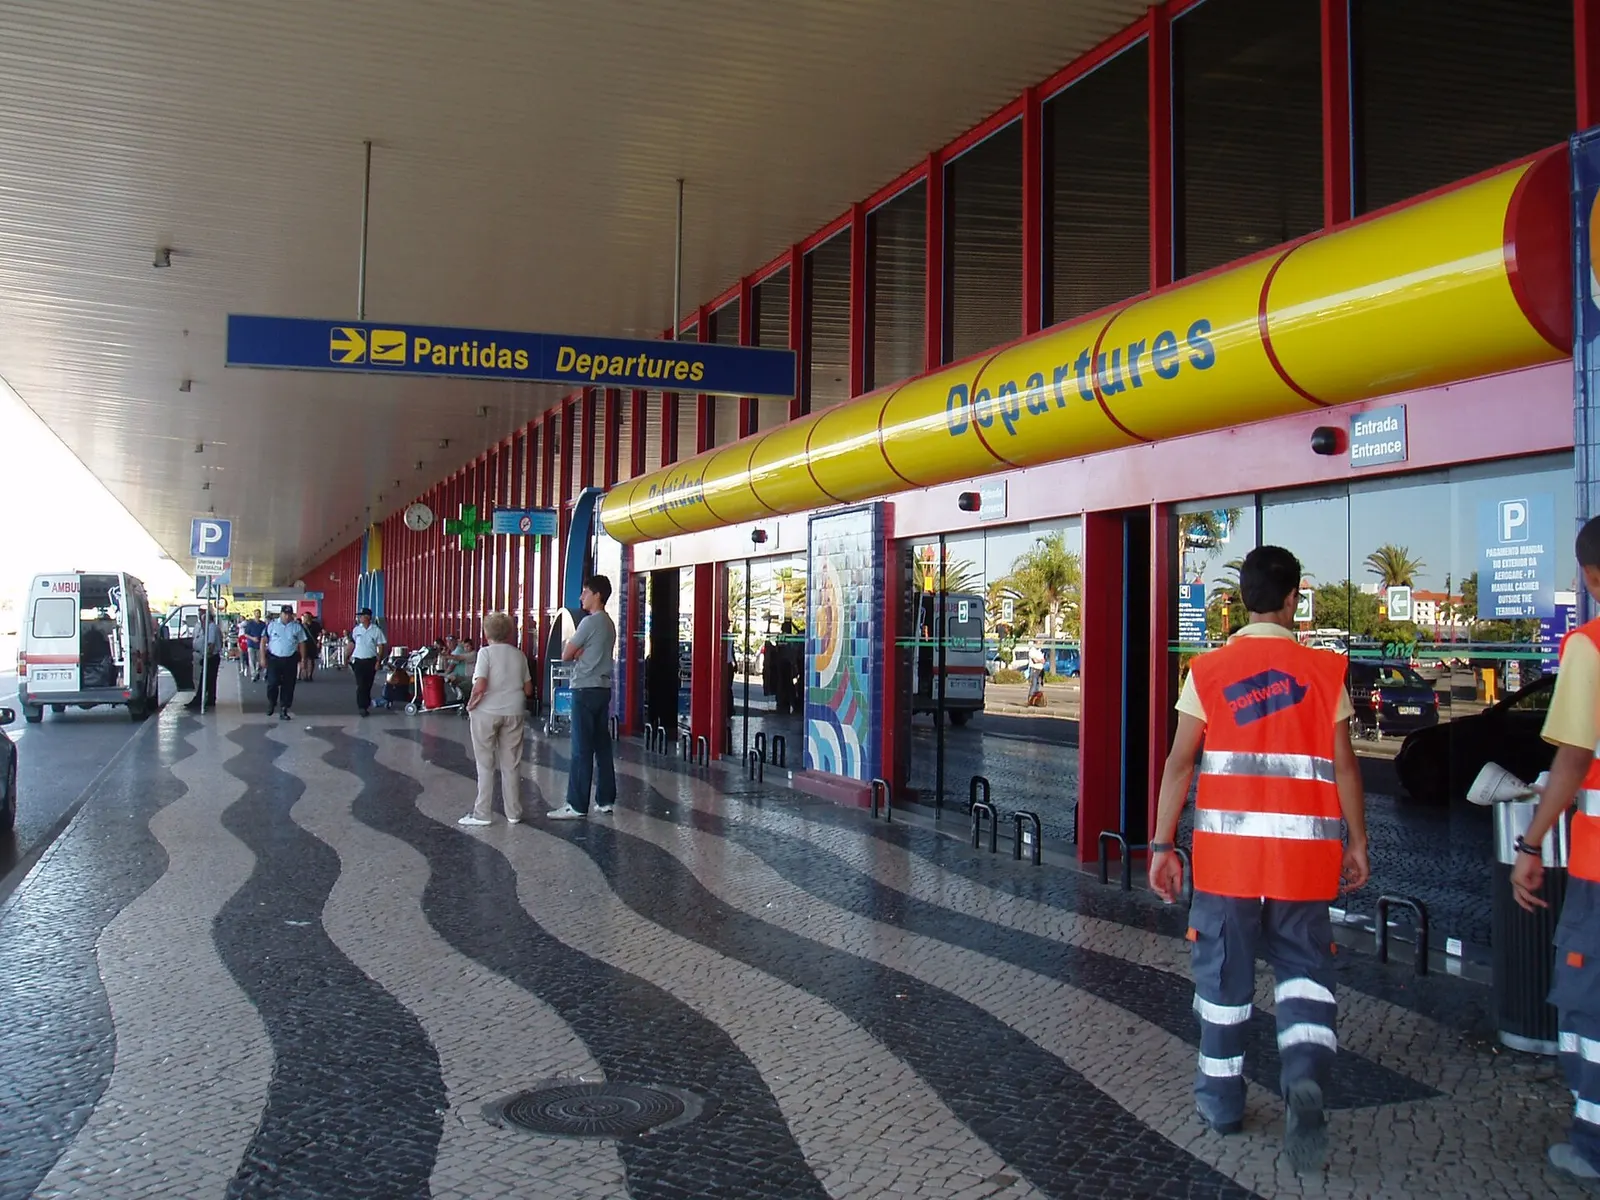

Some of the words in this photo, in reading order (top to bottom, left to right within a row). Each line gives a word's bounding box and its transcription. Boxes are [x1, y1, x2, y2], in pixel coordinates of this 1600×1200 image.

[413, 337, 529, 370] Partidas
[556, 346, 705, 381] Departures
[946, 319, 1216, 436] Departures
[1354, 416, 1399, 437] Entrada
[1351, 440, 1402, 459] Entrance
[1503, 502, 1526, 540] P
[199, 522, 223, 553] P
[1520, 544, 1545, 555] MANUAL
[1502, 557, 1528, 568] EXTERIOR
[1528, 569, 1536, 579] P1
[1491, 583, 1515, 593] MANUAL
[1515, 581, 1540, 591] CASHIER
[1498, 595, 1521, 604] OUTSIDE
[1521, 594, 1533, 603] THE
[1495, 606, 1523, 616] TERMINAL
[1528, 606, 1536, 615] P1
